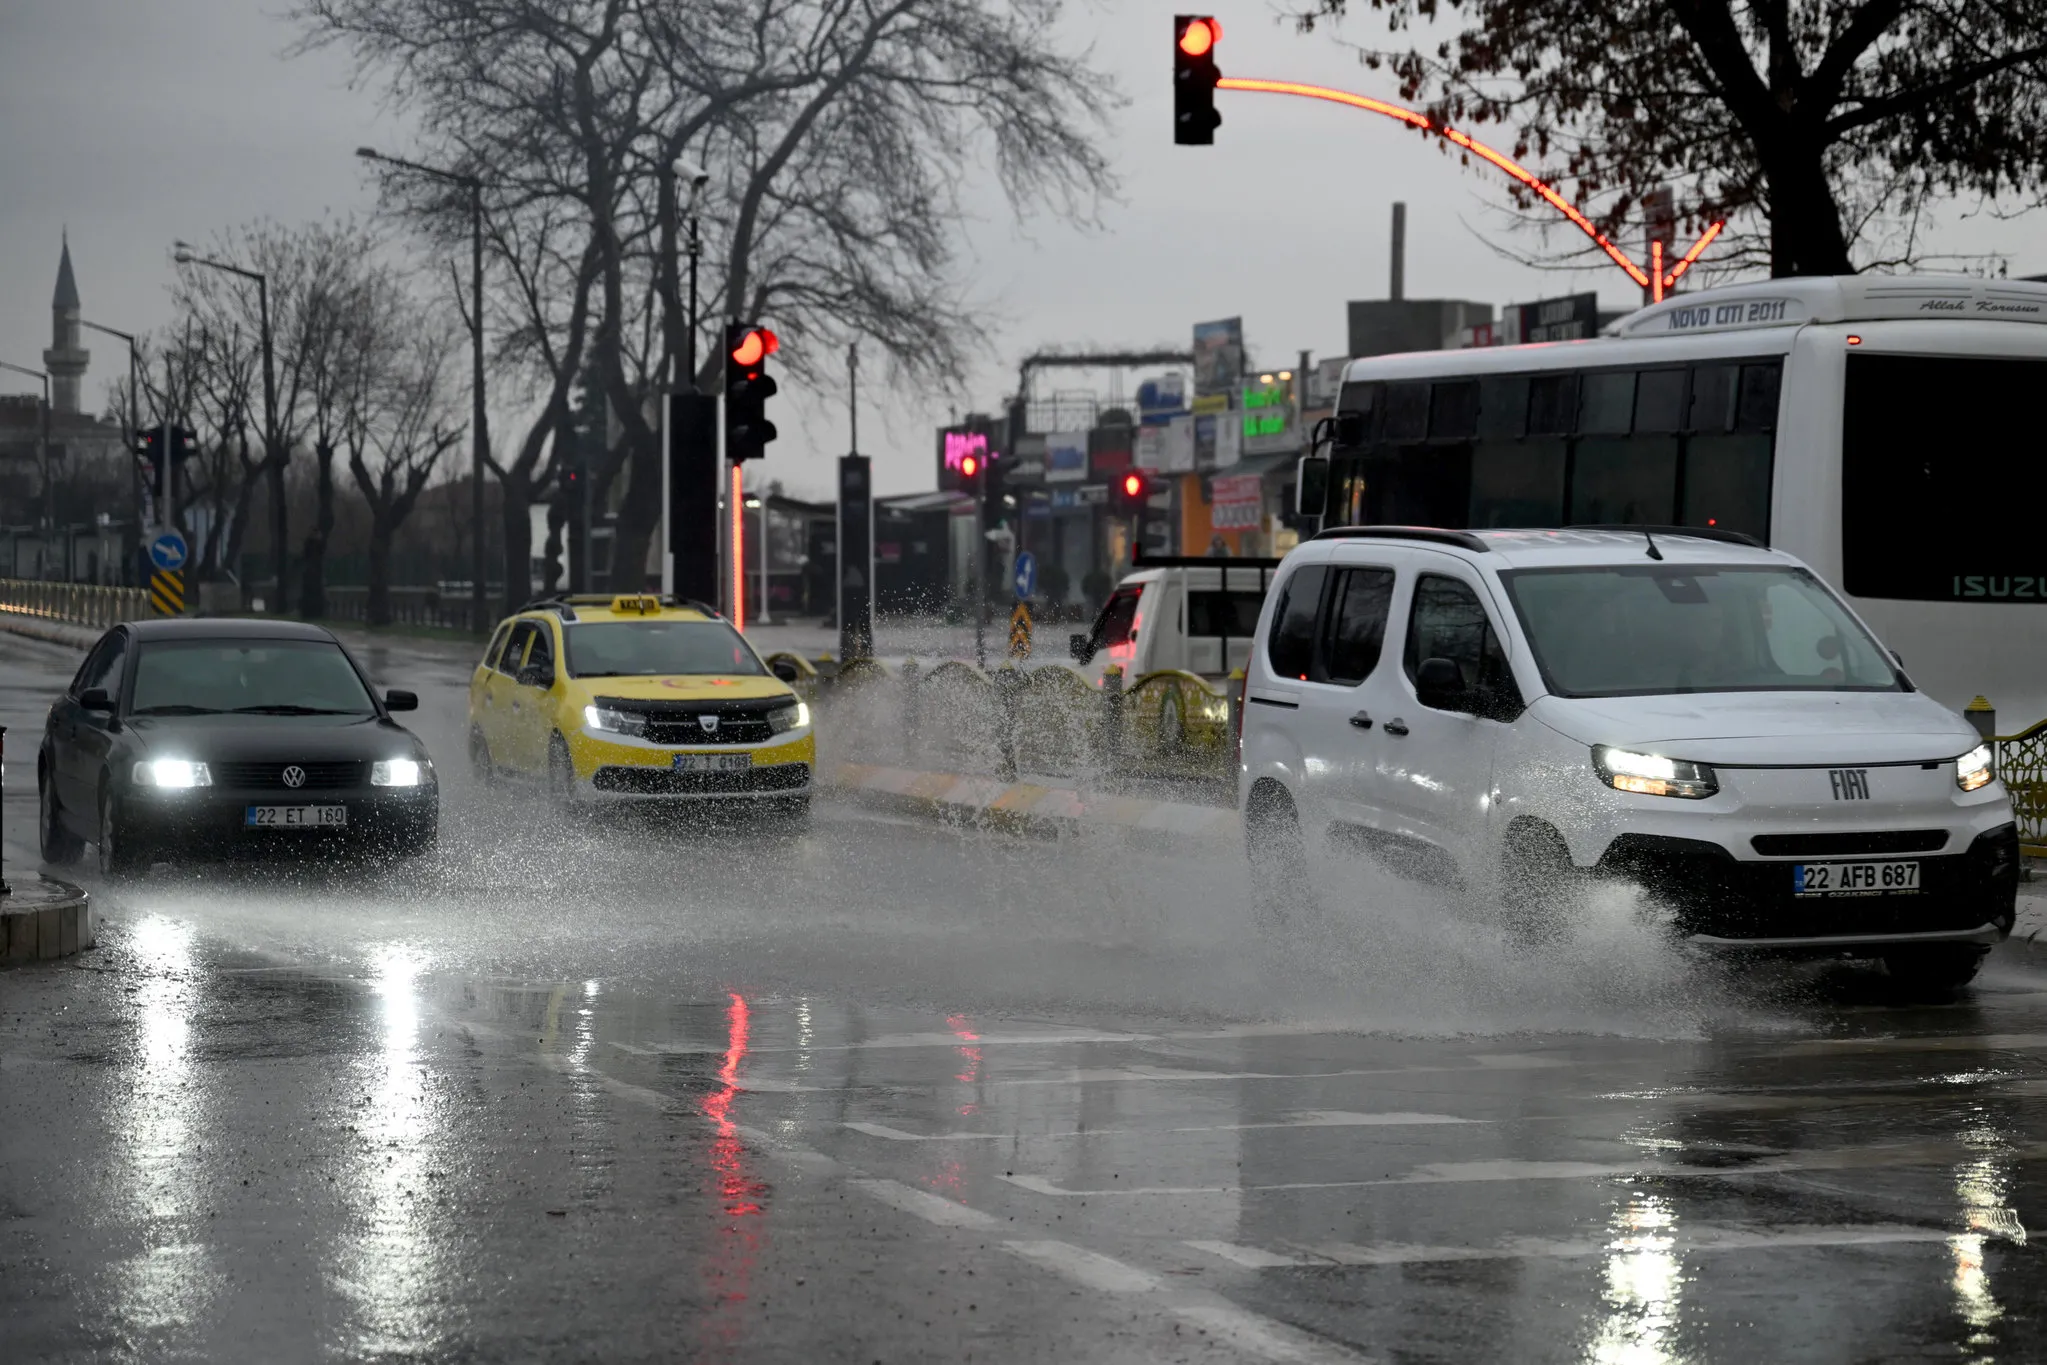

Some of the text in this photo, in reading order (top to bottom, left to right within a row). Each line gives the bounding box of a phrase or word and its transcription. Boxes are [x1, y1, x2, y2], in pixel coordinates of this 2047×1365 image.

[1669, 307, 1710, 329] NOVO
[1748, 300, 1787, 321] 2011
[1920, 300, 2040, 312] Allah Korusun
[1829, 769, 1869, 800] FIAT
[257, 808, 344, 823] 22 ET 160
[1804, 864, 1917, 889] 22 AFB 687
